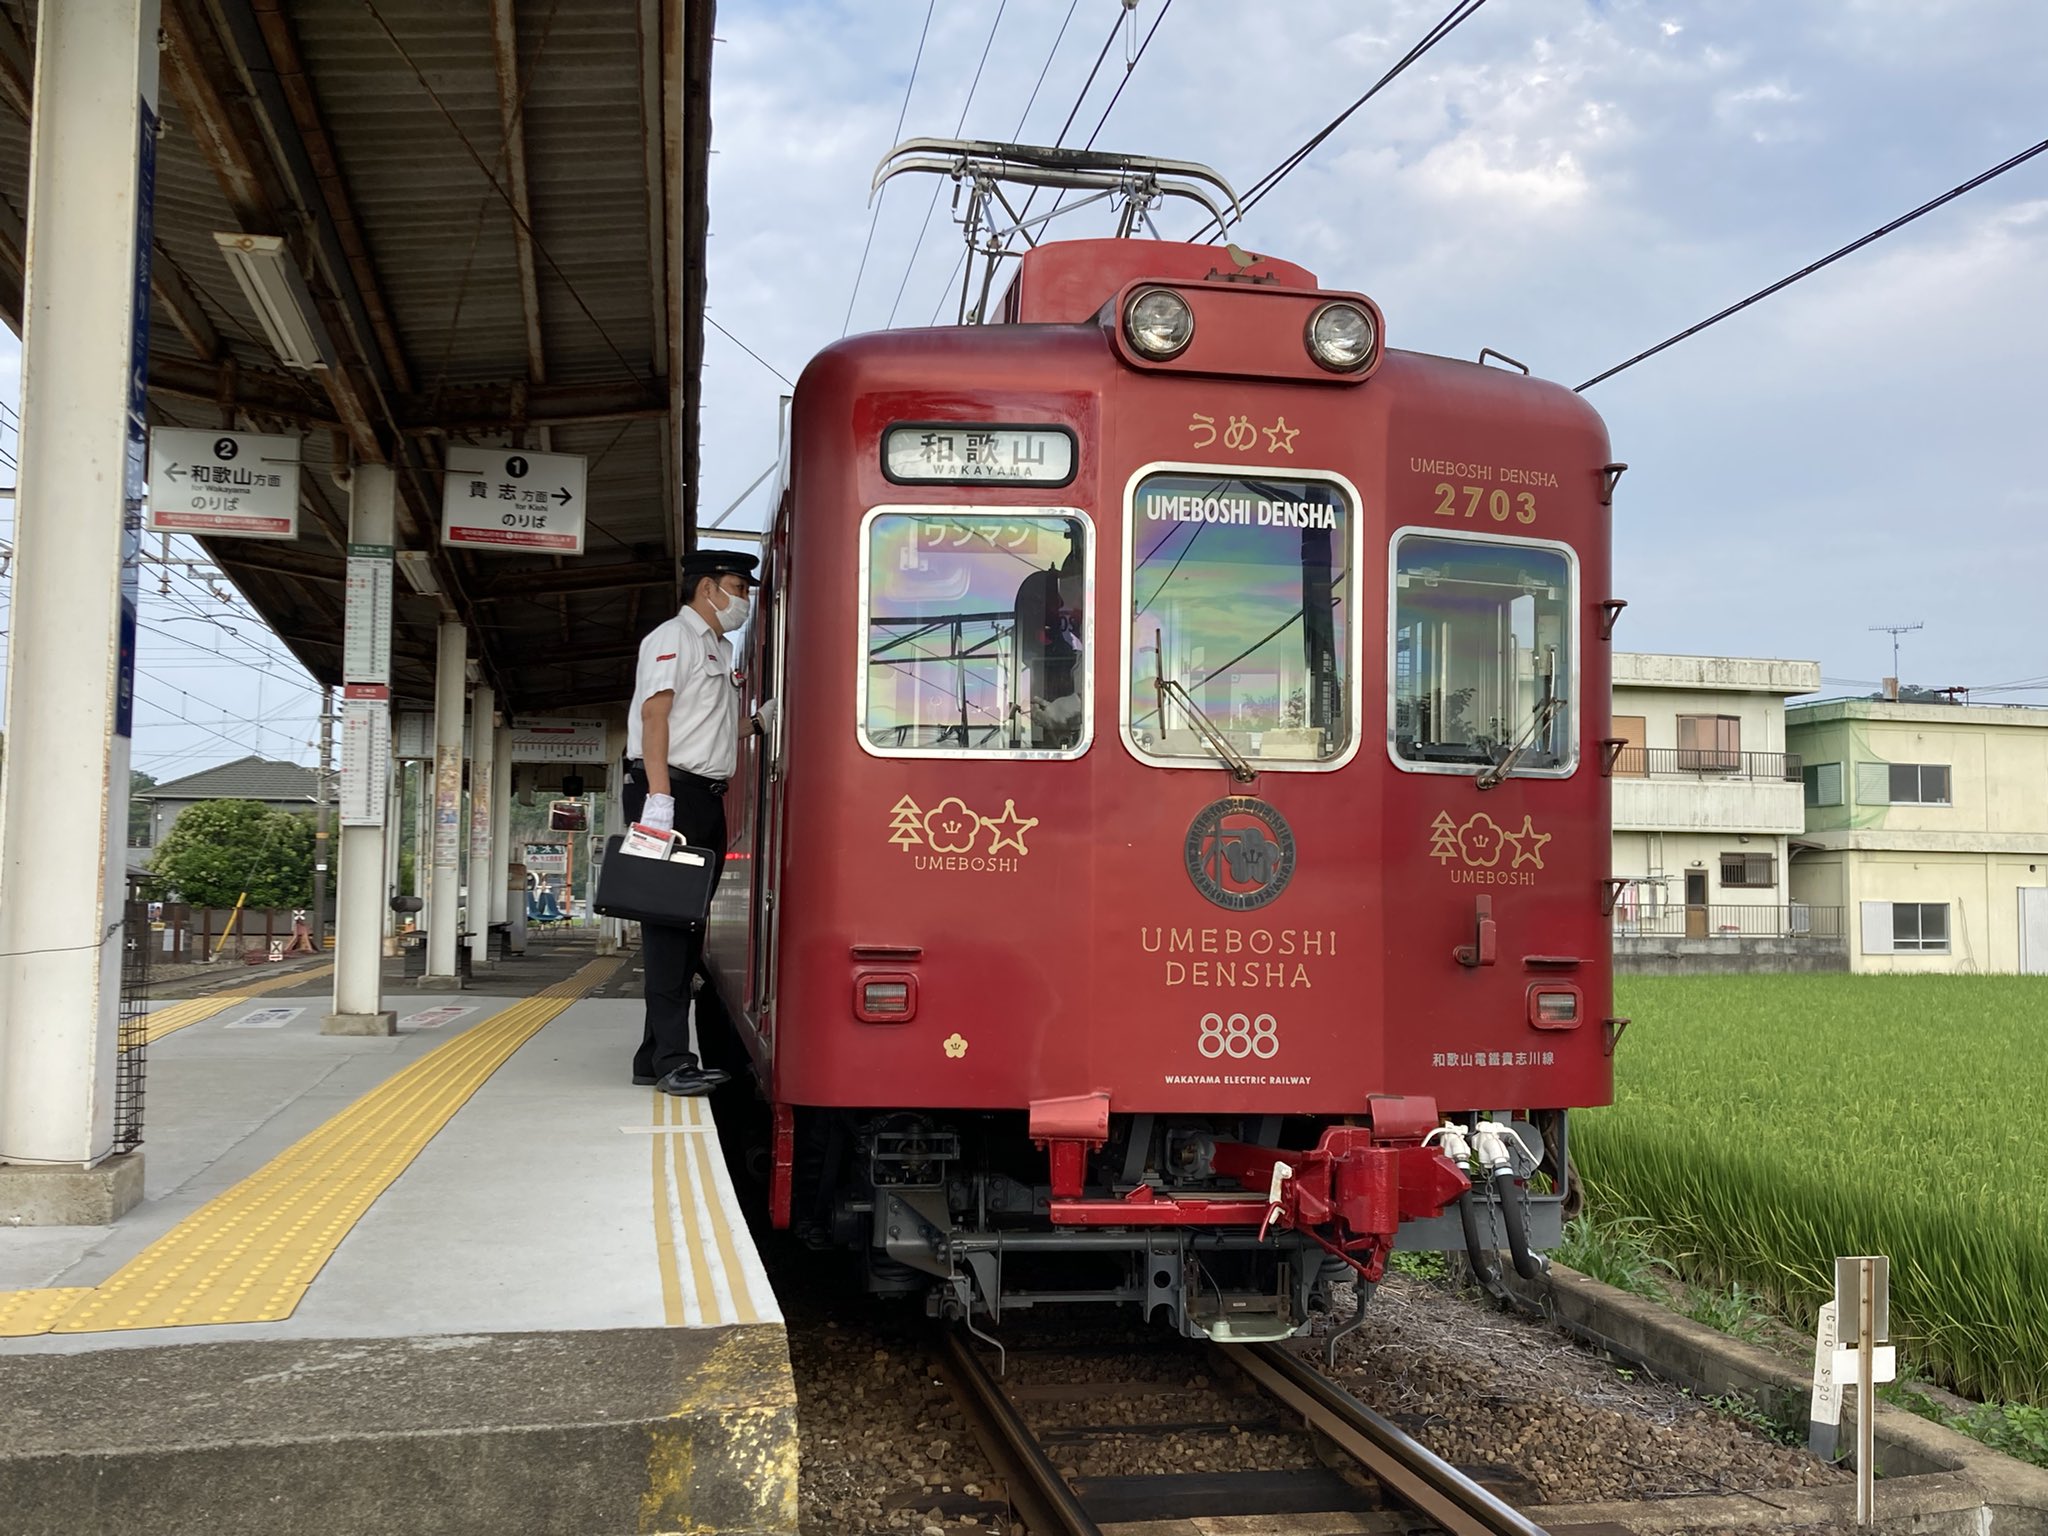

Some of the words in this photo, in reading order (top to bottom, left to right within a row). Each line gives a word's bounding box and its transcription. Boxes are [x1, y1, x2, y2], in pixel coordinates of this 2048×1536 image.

[919, 433, 1045, 466] 和歌山
[933, 464, 1033, 477] WAKAYAMA
[1410, 457, 1493, 481] UMEBOSHI
[1500, 467, 1559, 488] DENSHA
[205, 485, 251, 495] Wakayama
[191, 496, 240, 512] のりば
[515, 503, 527, 511] for
[528, 504, 549, 512] Kishi
[1147, 494, 1251, 525] UMEBOSHI
[1257, 500, 1337, 530] DENSHA
[1434, 482, 1537, 525] 2703
[501, 513, 547, 529] のりば
[924, 523, 1030, 549] ワンマン
[914, 855, 1018, 873] UMEBOSHI
[1450, 869, 1535, 886] UMEBOSHI
[1140, 927, 1337, 955] UMEBOSHI
[1165, 961, 1312, 988] DENSHA
[1198, 1012, 1279, 1059] 888
[1432, 1051, 1555, 1068] 和歌山電鐵貴志川線
[1164, 1075, 1221, 1084] WAKAYAMA
[1223, 1075, 1267, 1084] ELECTRIC
[1269, 1076, 1312, 1085] RAILWAY
